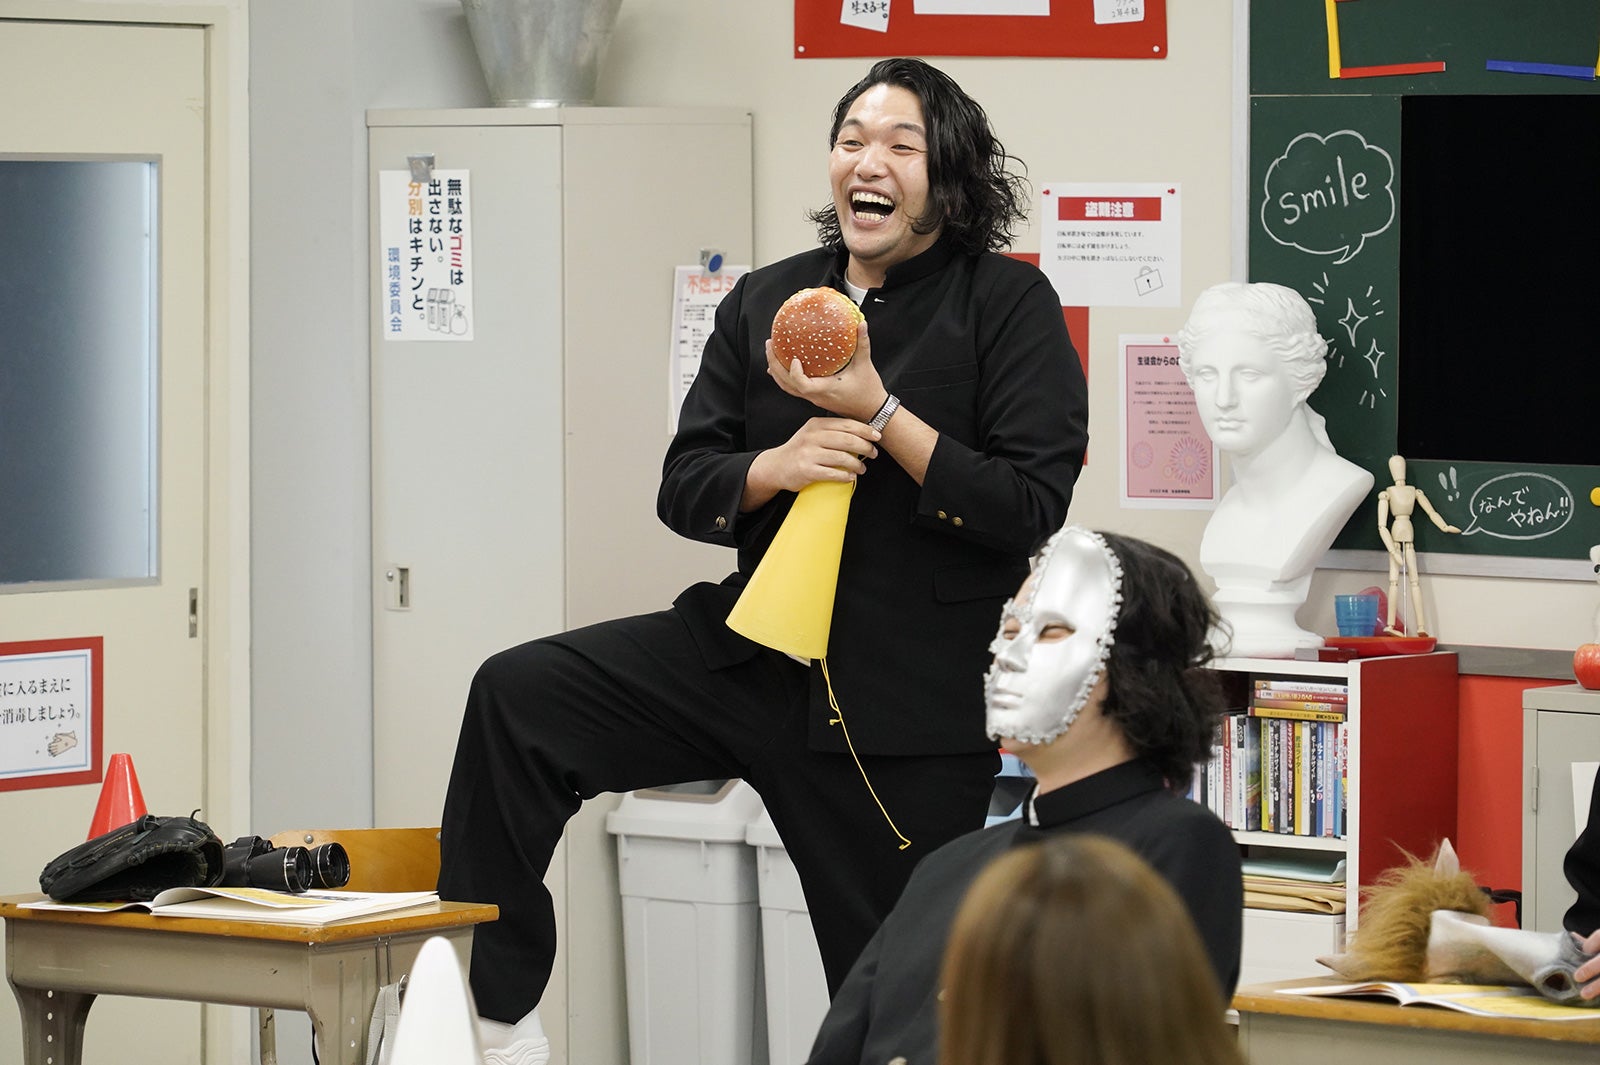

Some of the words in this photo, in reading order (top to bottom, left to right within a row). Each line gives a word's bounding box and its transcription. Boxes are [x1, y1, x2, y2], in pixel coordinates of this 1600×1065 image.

[428, 178, 444, 263] 出さない。
[1085, 201, 1134, 217] 盗難注意
[1279, 155, 1371, 225] smile
[408, 179, 426, 320] 分別はキチンと。
[447, 178, 464, 286] 無駄なゴミは
[388, 247, 402, 332] 環境委員会
[1479, 486, 1530, 514] なんで
[0, 678, 71, 698] に入るまえに
[0, 703, 80, 725] 消毒しましょう。
